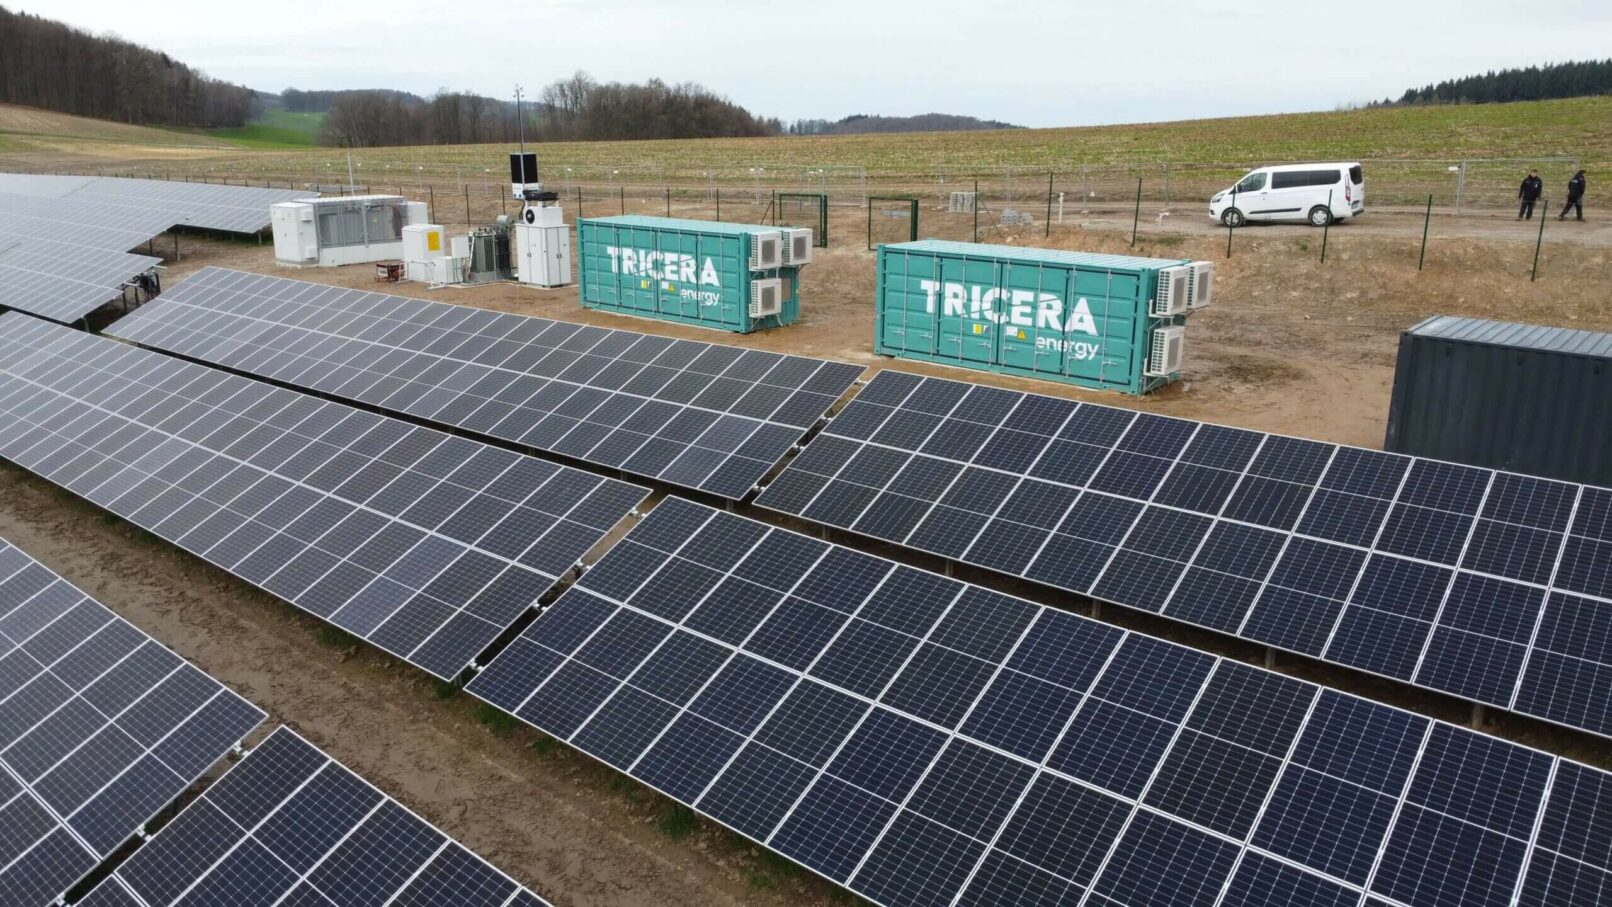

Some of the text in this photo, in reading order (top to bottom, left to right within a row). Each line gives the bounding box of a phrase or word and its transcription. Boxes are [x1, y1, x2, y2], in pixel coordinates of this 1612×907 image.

[607, 246, 720, 287] TRICERA
[681, 288, 720, 306] energy
[920, 280, 1099, 336] TRICERA
[1036, 336, 1099, 360] energy
